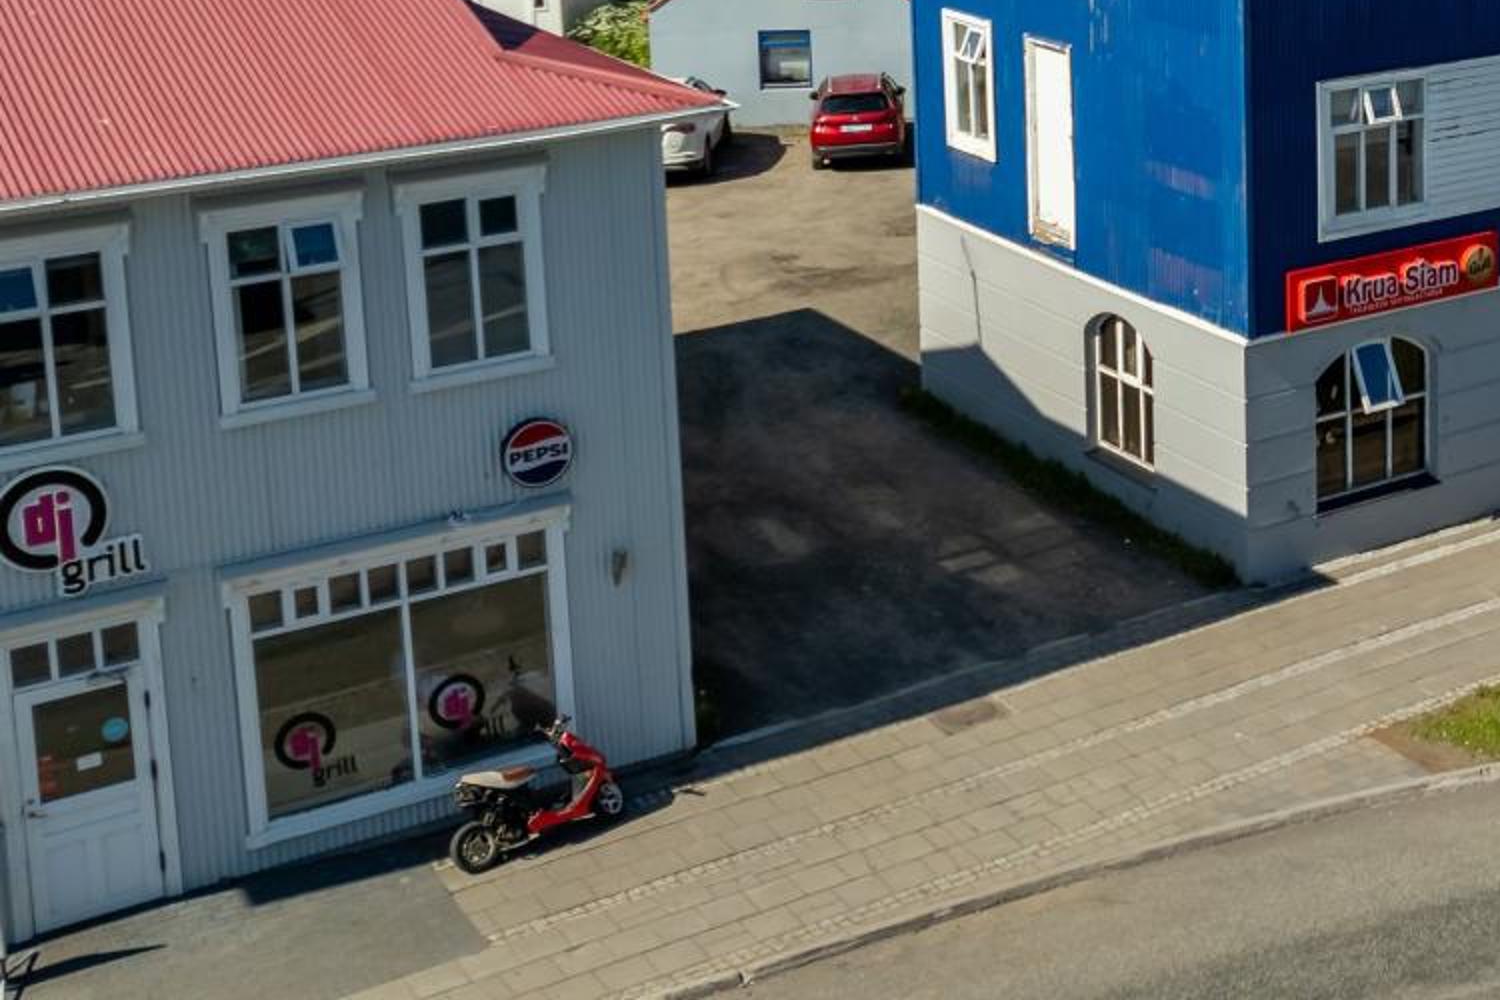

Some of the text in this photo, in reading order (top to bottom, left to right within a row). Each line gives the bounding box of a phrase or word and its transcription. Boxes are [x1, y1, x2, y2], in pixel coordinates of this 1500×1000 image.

[1344, 276, 1398, 305] Krua
[1405, 259, 1459, 291] Siam
[509, 442, 569, 466] PEPSI
[61, 538, 146, 594] grill
[312, 755, 358, 788] grill
